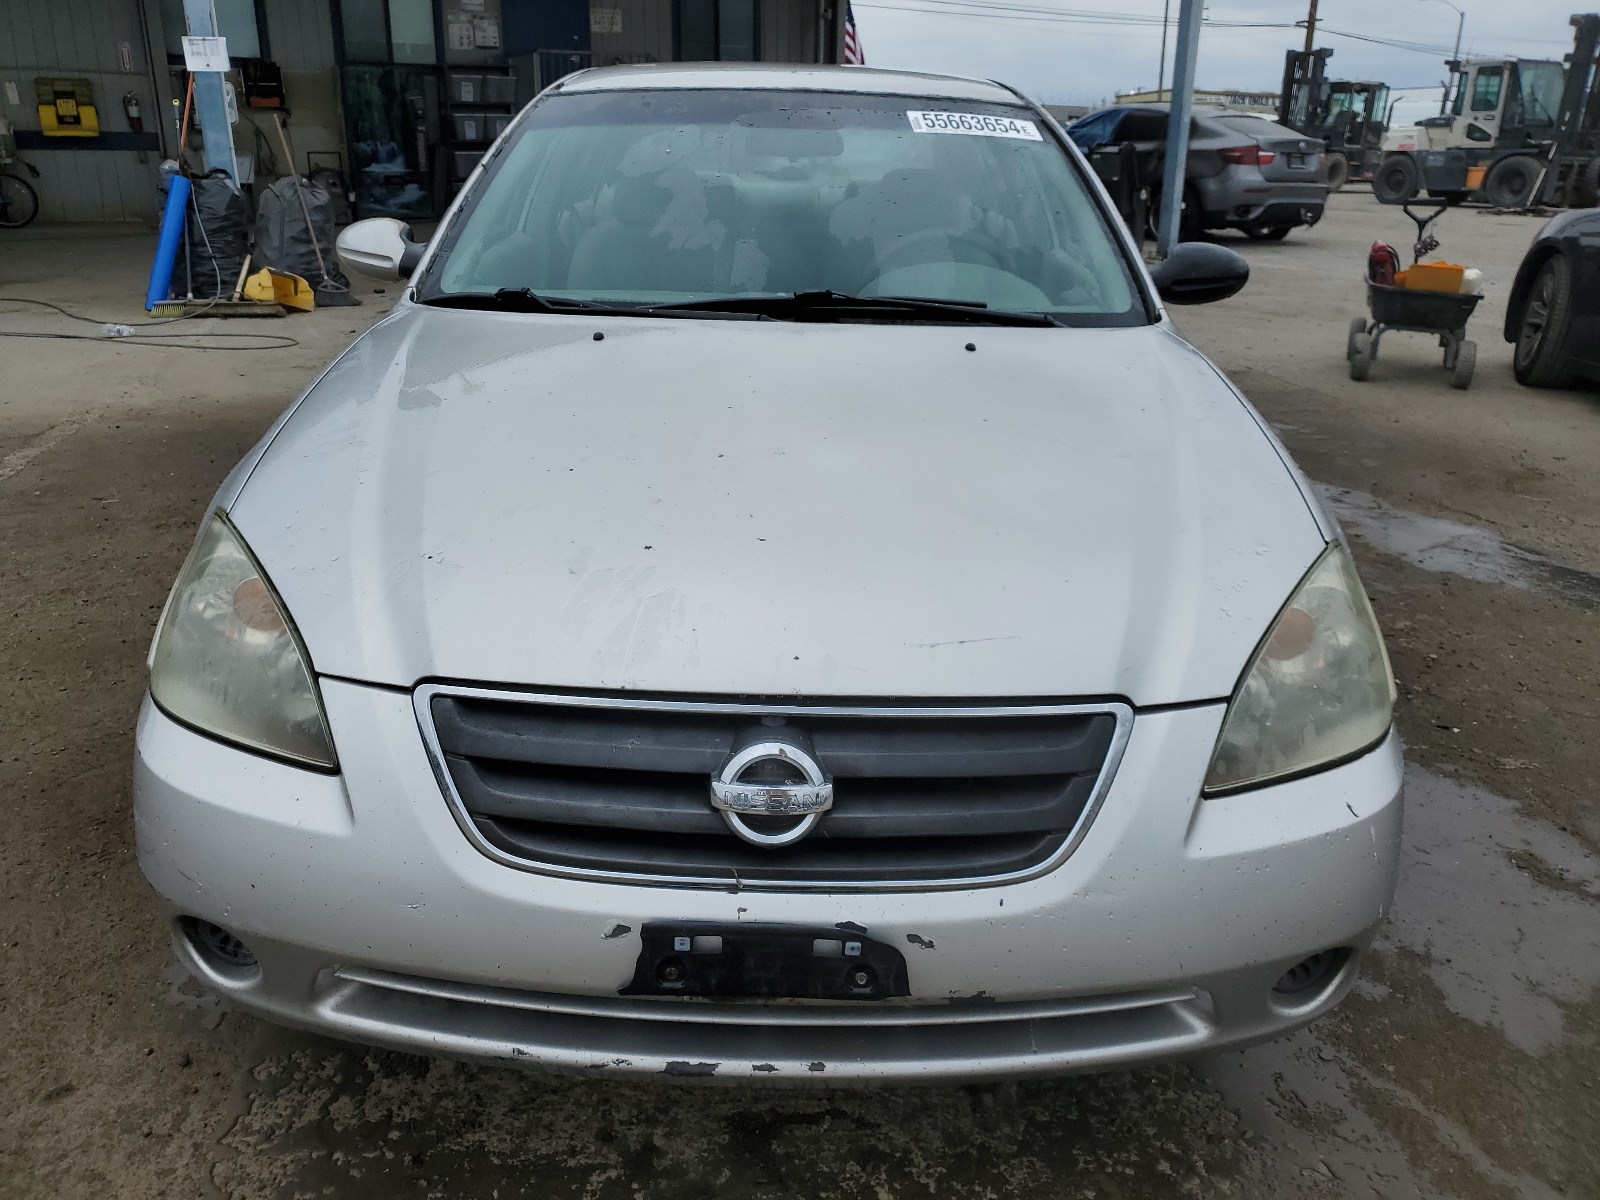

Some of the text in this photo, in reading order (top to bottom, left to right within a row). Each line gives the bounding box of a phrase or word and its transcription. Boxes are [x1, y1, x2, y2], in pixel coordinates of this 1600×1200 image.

[922, 113, 1030, 135] 55663654 E
[724, 790, 820, 812] NISSAN
